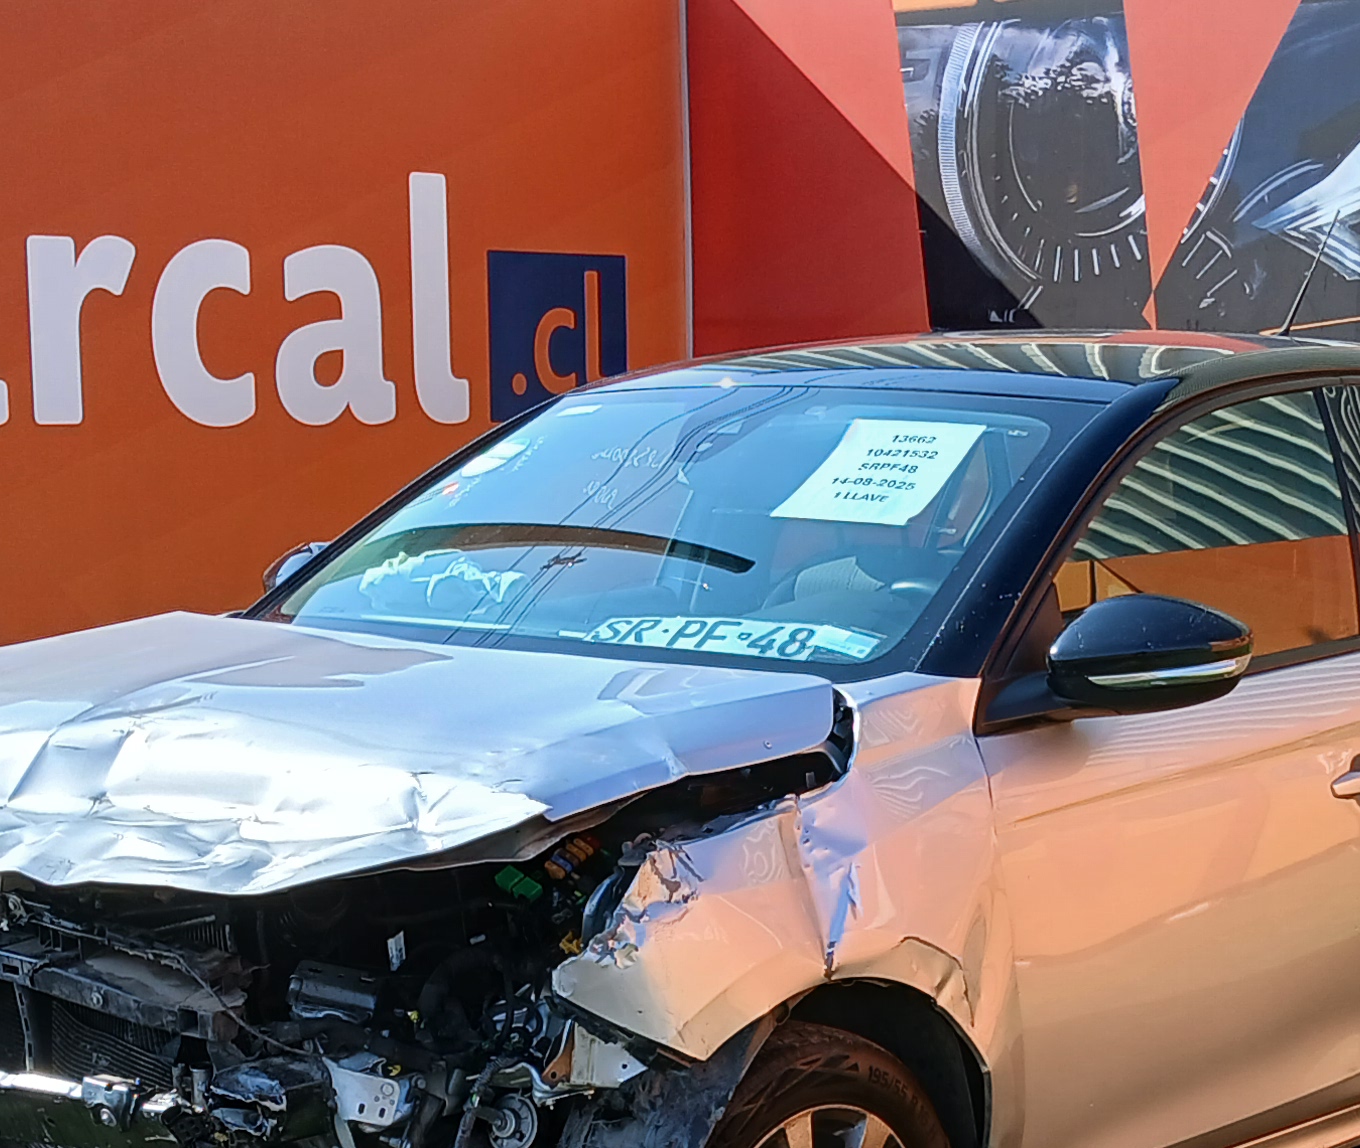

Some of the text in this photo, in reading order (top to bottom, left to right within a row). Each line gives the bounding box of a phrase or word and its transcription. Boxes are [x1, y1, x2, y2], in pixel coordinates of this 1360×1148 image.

[891, 434, 936, 443] 13662
[866, 448, 938, 459] 10421532
[857, 462, 918, 473] SRPF48
[831, 477, 916, 490] 14-08-2025
[843, 491, 889, 502] LLAVE
[868, 1064, 909, 1102] 195/55
